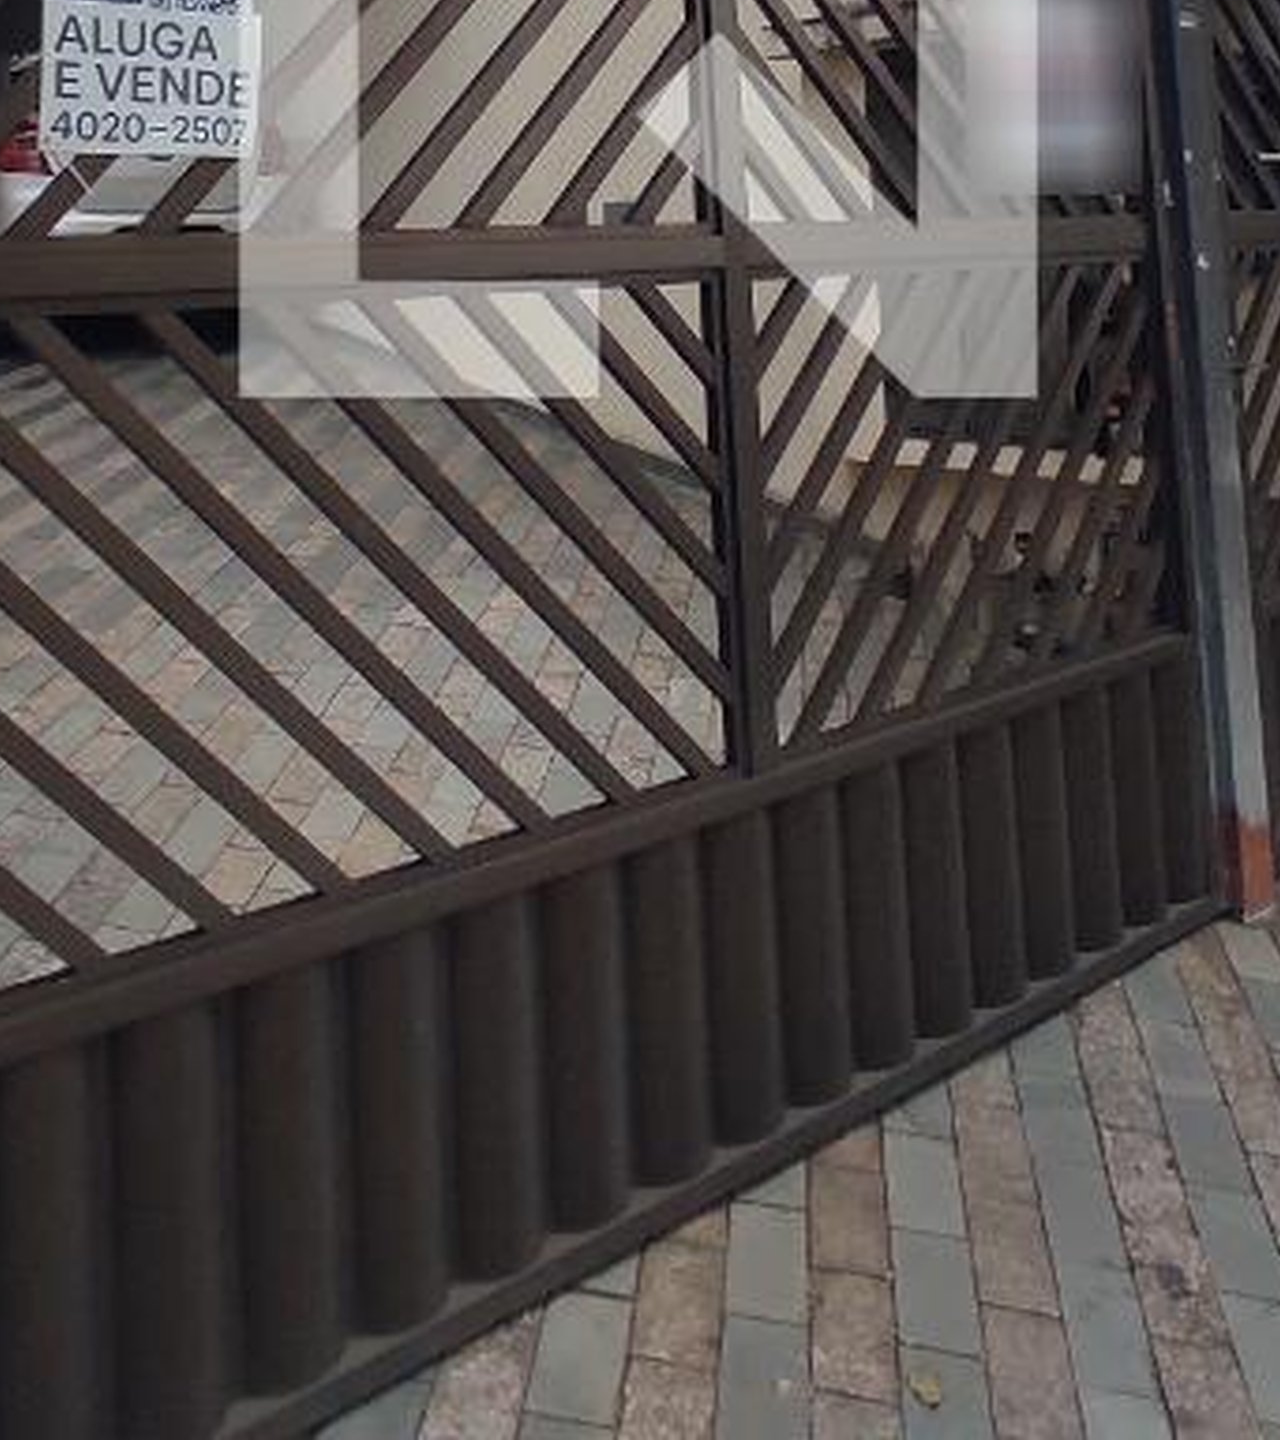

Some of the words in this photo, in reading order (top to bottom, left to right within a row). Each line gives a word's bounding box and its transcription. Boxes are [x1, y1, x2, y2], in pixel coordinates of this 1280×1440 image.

[55, 16, 218, 60] ALUGA
[55, 63, 81, 99] E
[96, 64, 250, 107] VENDE
